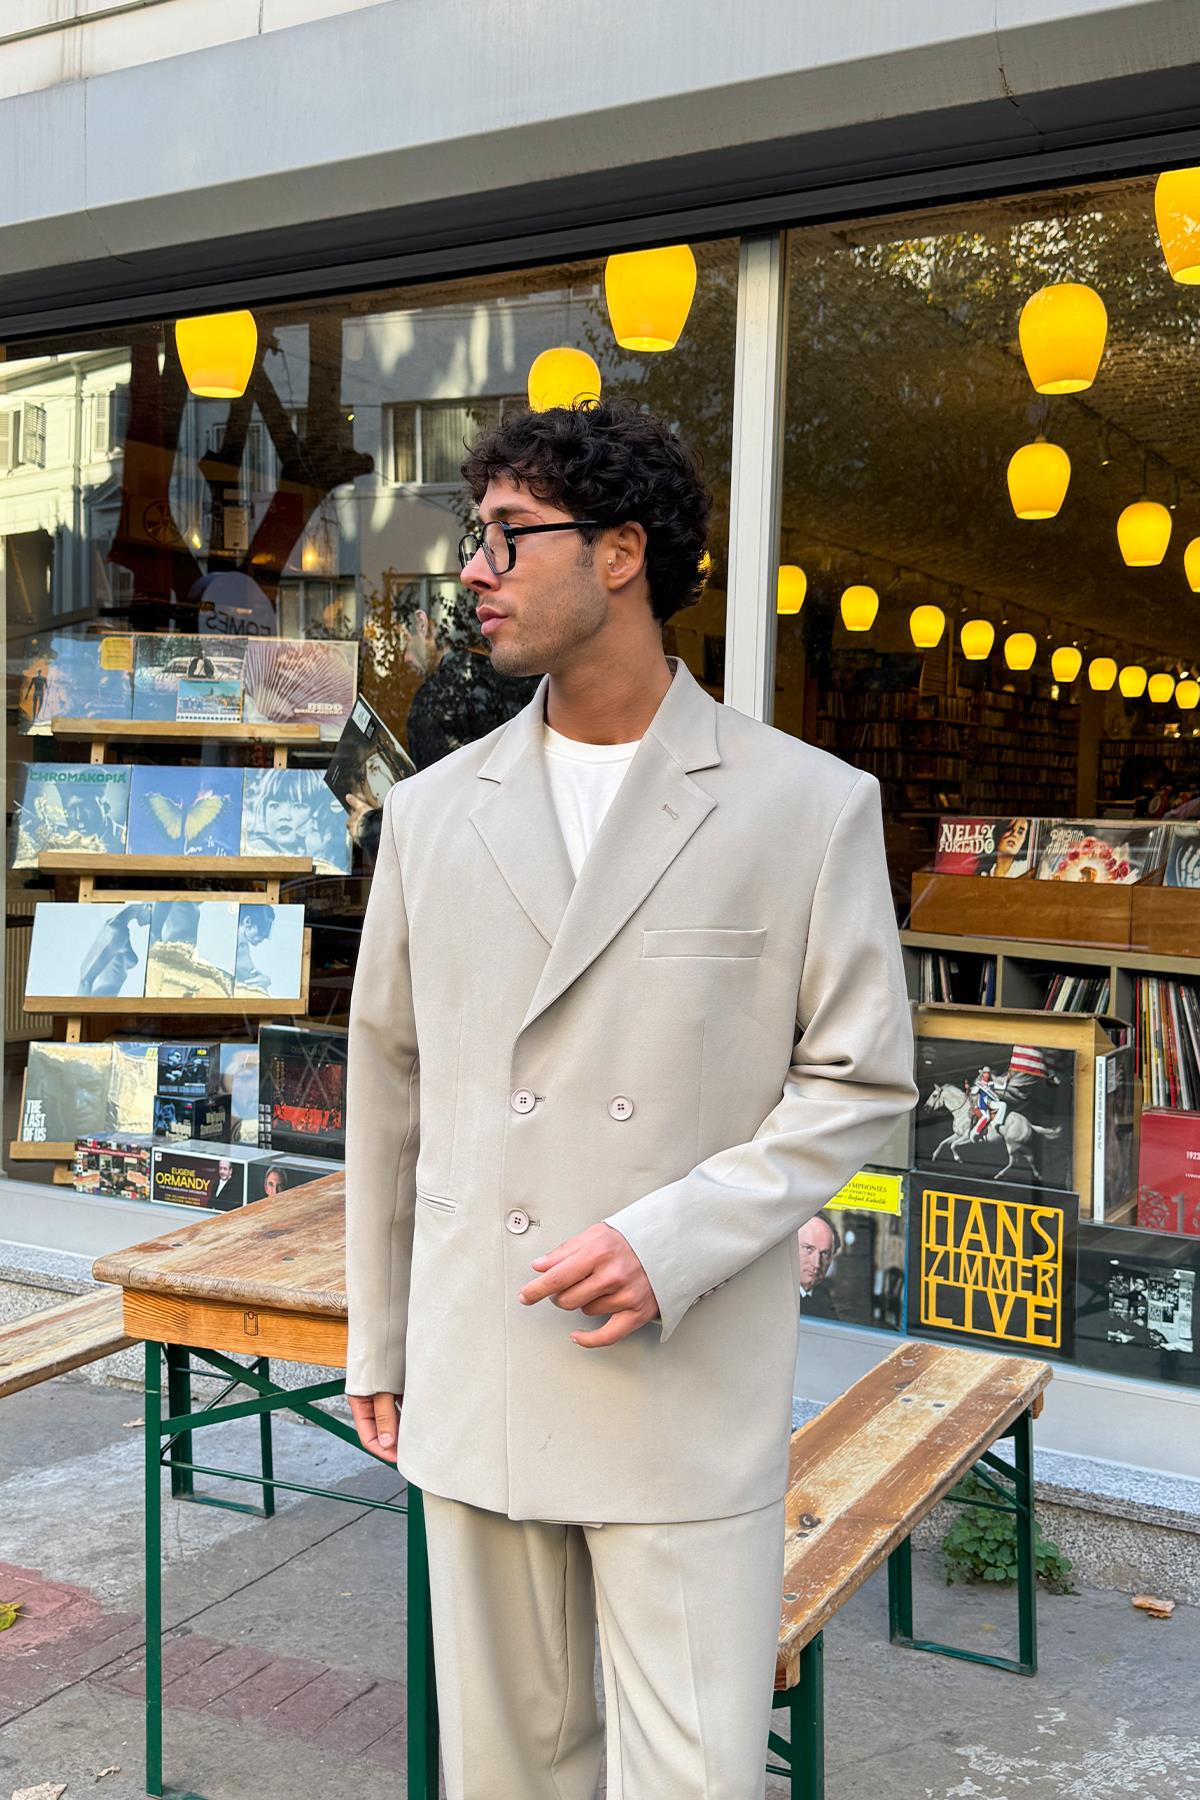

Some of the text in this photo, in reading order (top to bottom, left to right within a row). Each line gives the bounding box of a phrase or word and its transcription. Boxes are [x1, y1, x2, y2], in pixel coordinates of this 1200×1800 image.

[29, 768, 128, 783] CHROMAKOPIA
[940, 823, 996, 842] NELLY
[938, 838, 995, 854] FURTADO
[26, 1099, 42, 1114] THE
[24, 1113, 46, 1128] LAST
[23, 1127, 47, 1142] OF US
[171, 1167, 196, 1177] EUGENE
[155, 1172, 211, 1191] ORMANDY
[848, 1182, 887, 1193] YMPHONIES
[928, 1192, 1056, 1263] HANS
[928, 1248, 1054, 1300] ZIMMER
[928, 1279, 1053, 1343] LIVE
